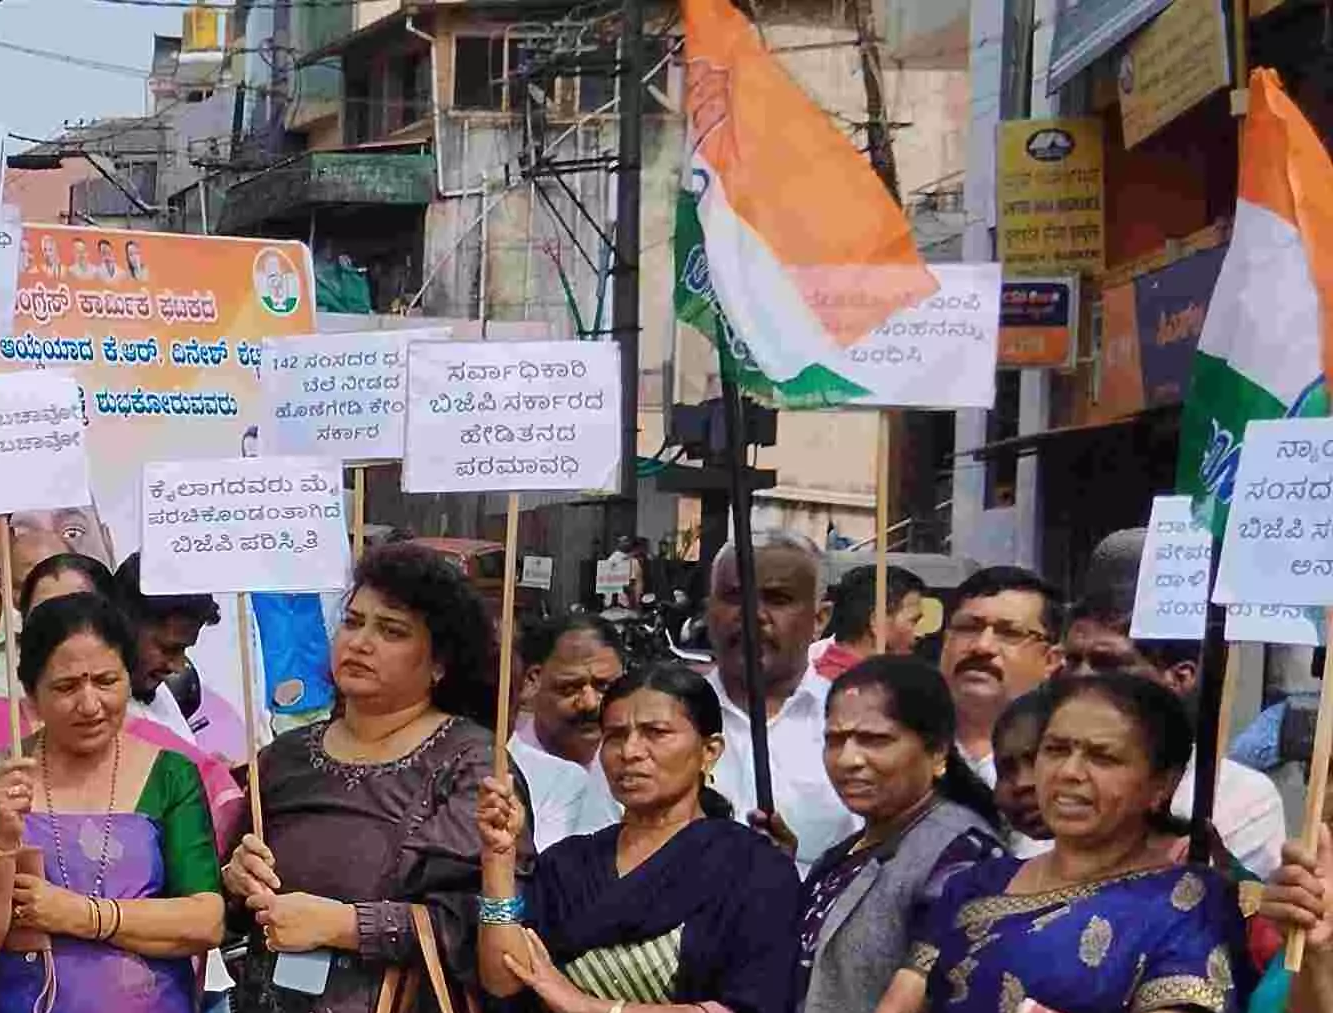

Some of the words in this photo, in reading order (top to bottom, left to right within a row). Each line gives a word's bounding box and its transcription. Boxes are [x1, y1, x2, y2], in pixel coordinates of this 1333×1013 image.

[14, 284, 68, 322] ಂಗ್ರೆಸ್
[273, 356, 298, 370] 142
[304, 352, 377, 369] ಸಂಸದರ
[447, 359, 587, 383] ಸರ್ವಾಧಿಕಾರಿ
[303, 376, 335, 392] ಬೆಲೆ
[370, 398, 404, 415] ಕೇಂ
[430, 391, 497, 413] ಬಿಜೆಪಿ
[504, 389, 604, 411] ಸರ್ಕಾರದ
[317, 424, 379, 440] ಸರ್ಕಾರ
[461, 423, 575, 445] ಹೇಡಿತನದ
[455, 455, 579, 478] ಪರಮಾವಧಿ
[149, 477, 293, 501] ಕೈಲಾಗದವರು
[1239, 517, 1304, 540] ಬಿಜೆಪಿ
[172, 533, 233, 553] ಬಿಜೆಪಿ
[239, 530, 318, 553] ಪರಿಸ್ಥಿತಿ
